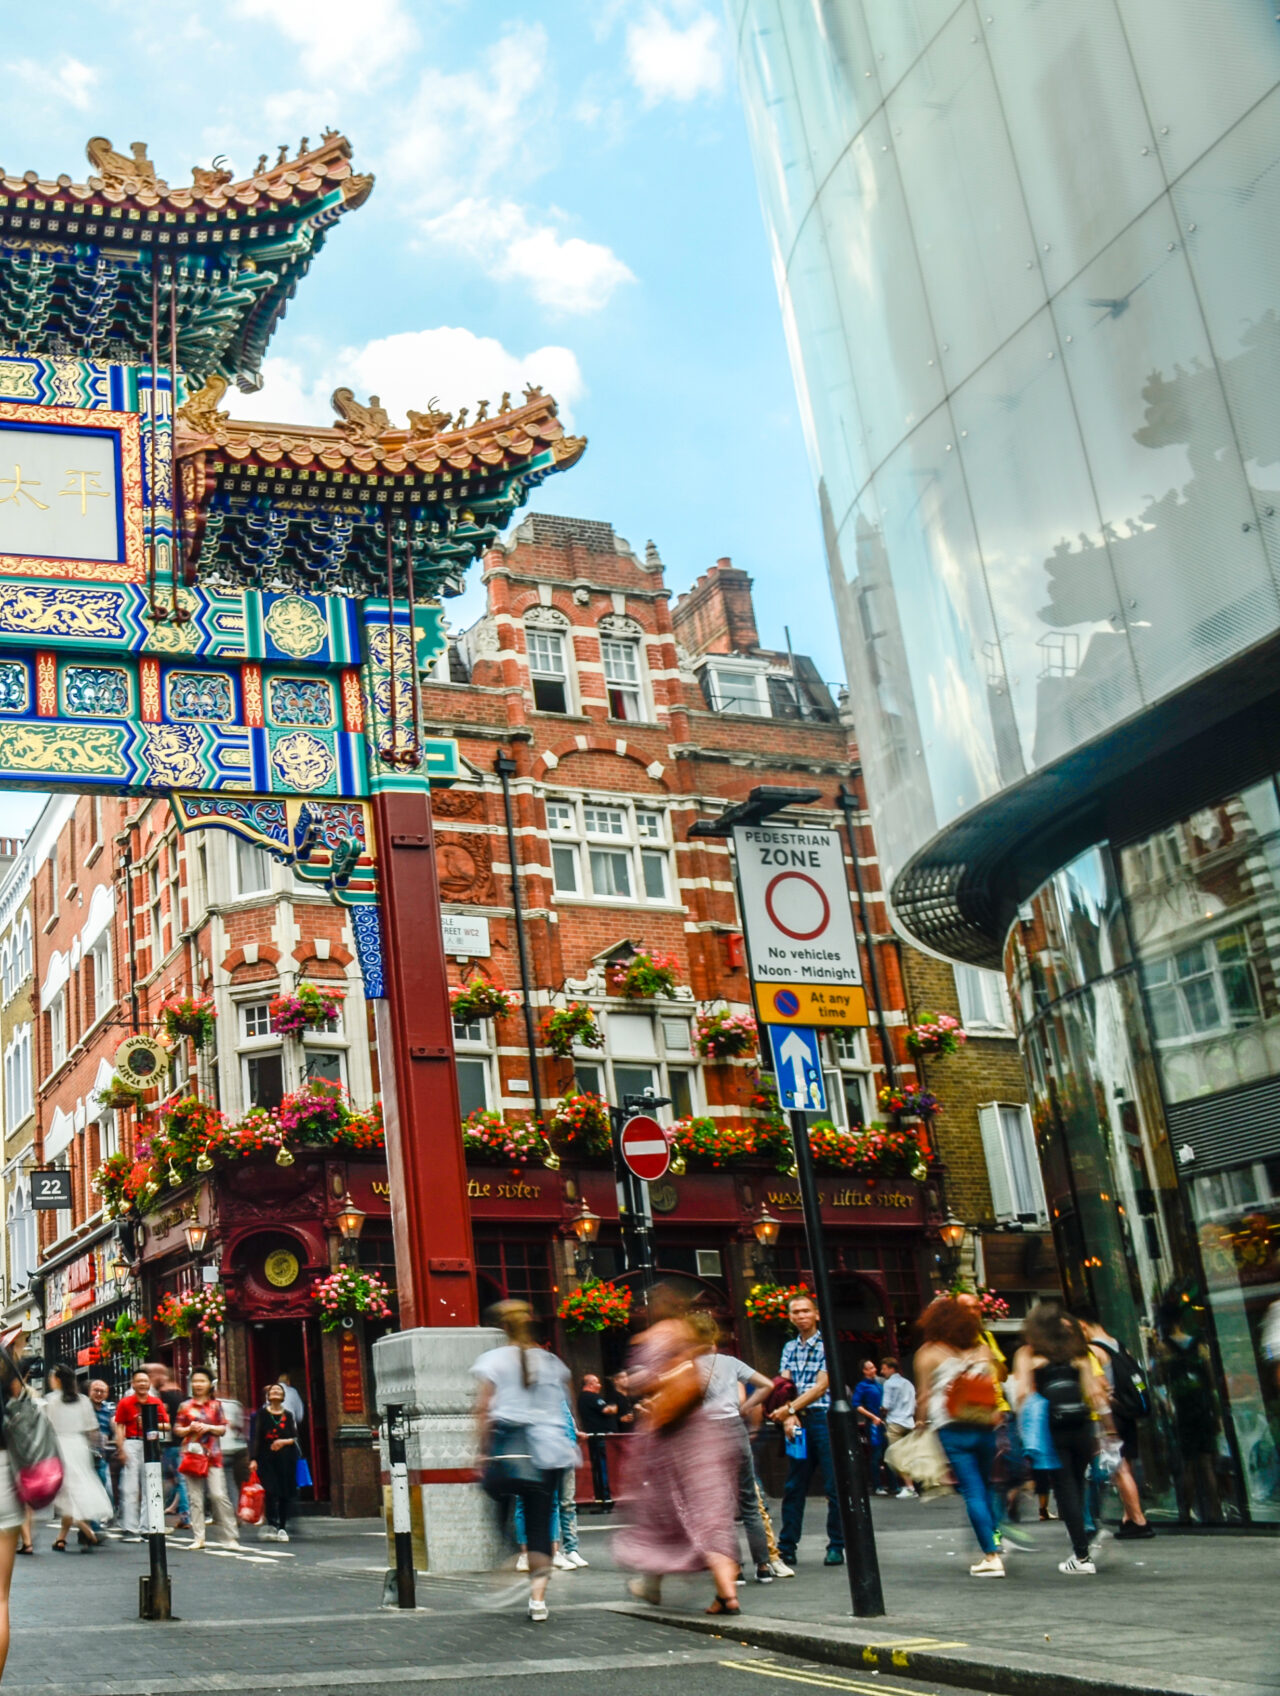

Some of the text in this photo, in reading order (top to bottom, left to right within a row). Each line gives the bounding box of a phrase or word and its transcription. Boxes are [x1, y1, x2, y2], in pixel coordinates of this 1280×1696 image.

[745, 831, 831, 847] PEDESTRIAN
[759, 848, 821, 868] ZONE
[768, 947, 841, 961] No vehicles
[758, 964, 792, 976] Noon
[802, 966, 856, 980] Midnight
[810, 992, 850, 1006] At any
[818, 1007, 846, 1019] time
[41, 1179, 62, 1195] 22
[497, 1180, 541, 1198] sister
[878, 1190, 915, 1208] sister
